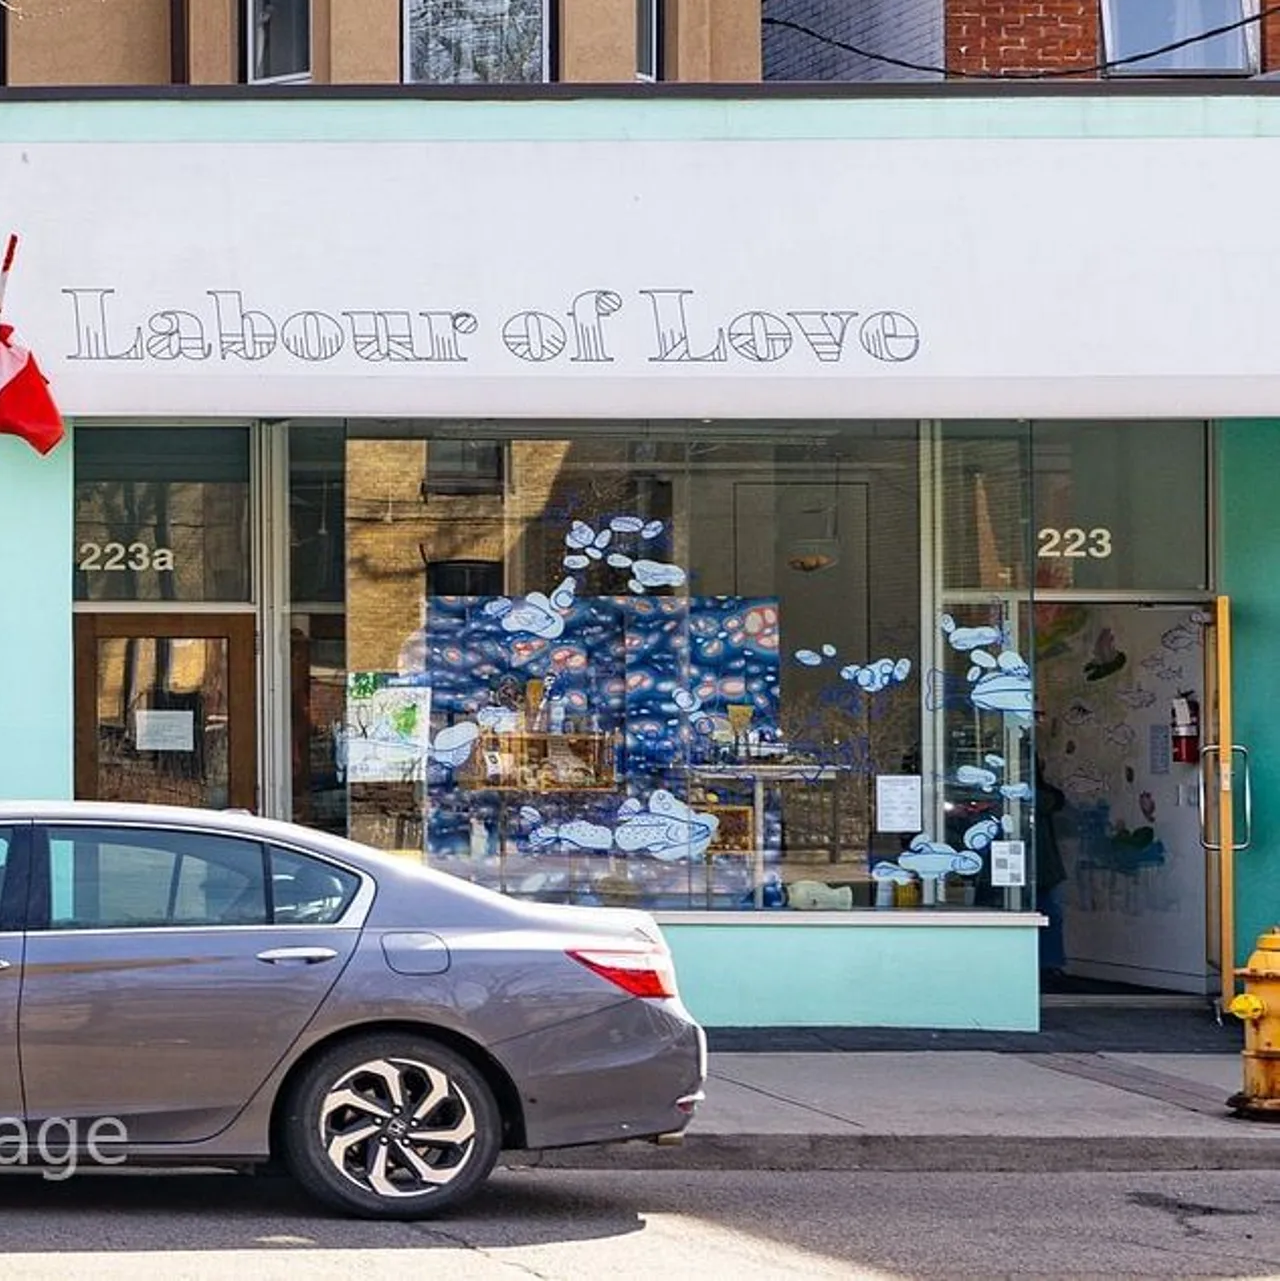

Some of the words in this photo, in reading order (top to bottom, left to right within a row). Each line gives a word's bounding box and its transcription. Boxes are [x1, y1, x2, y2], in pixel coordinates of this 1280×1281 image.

[61, 287, 478, 362] Labour
[502, 289, 623, 362] of
[638, 289, 920, 362] Love
[80, 542, 175, 571] 223a
[1037, 528, 1112, 558] 223
